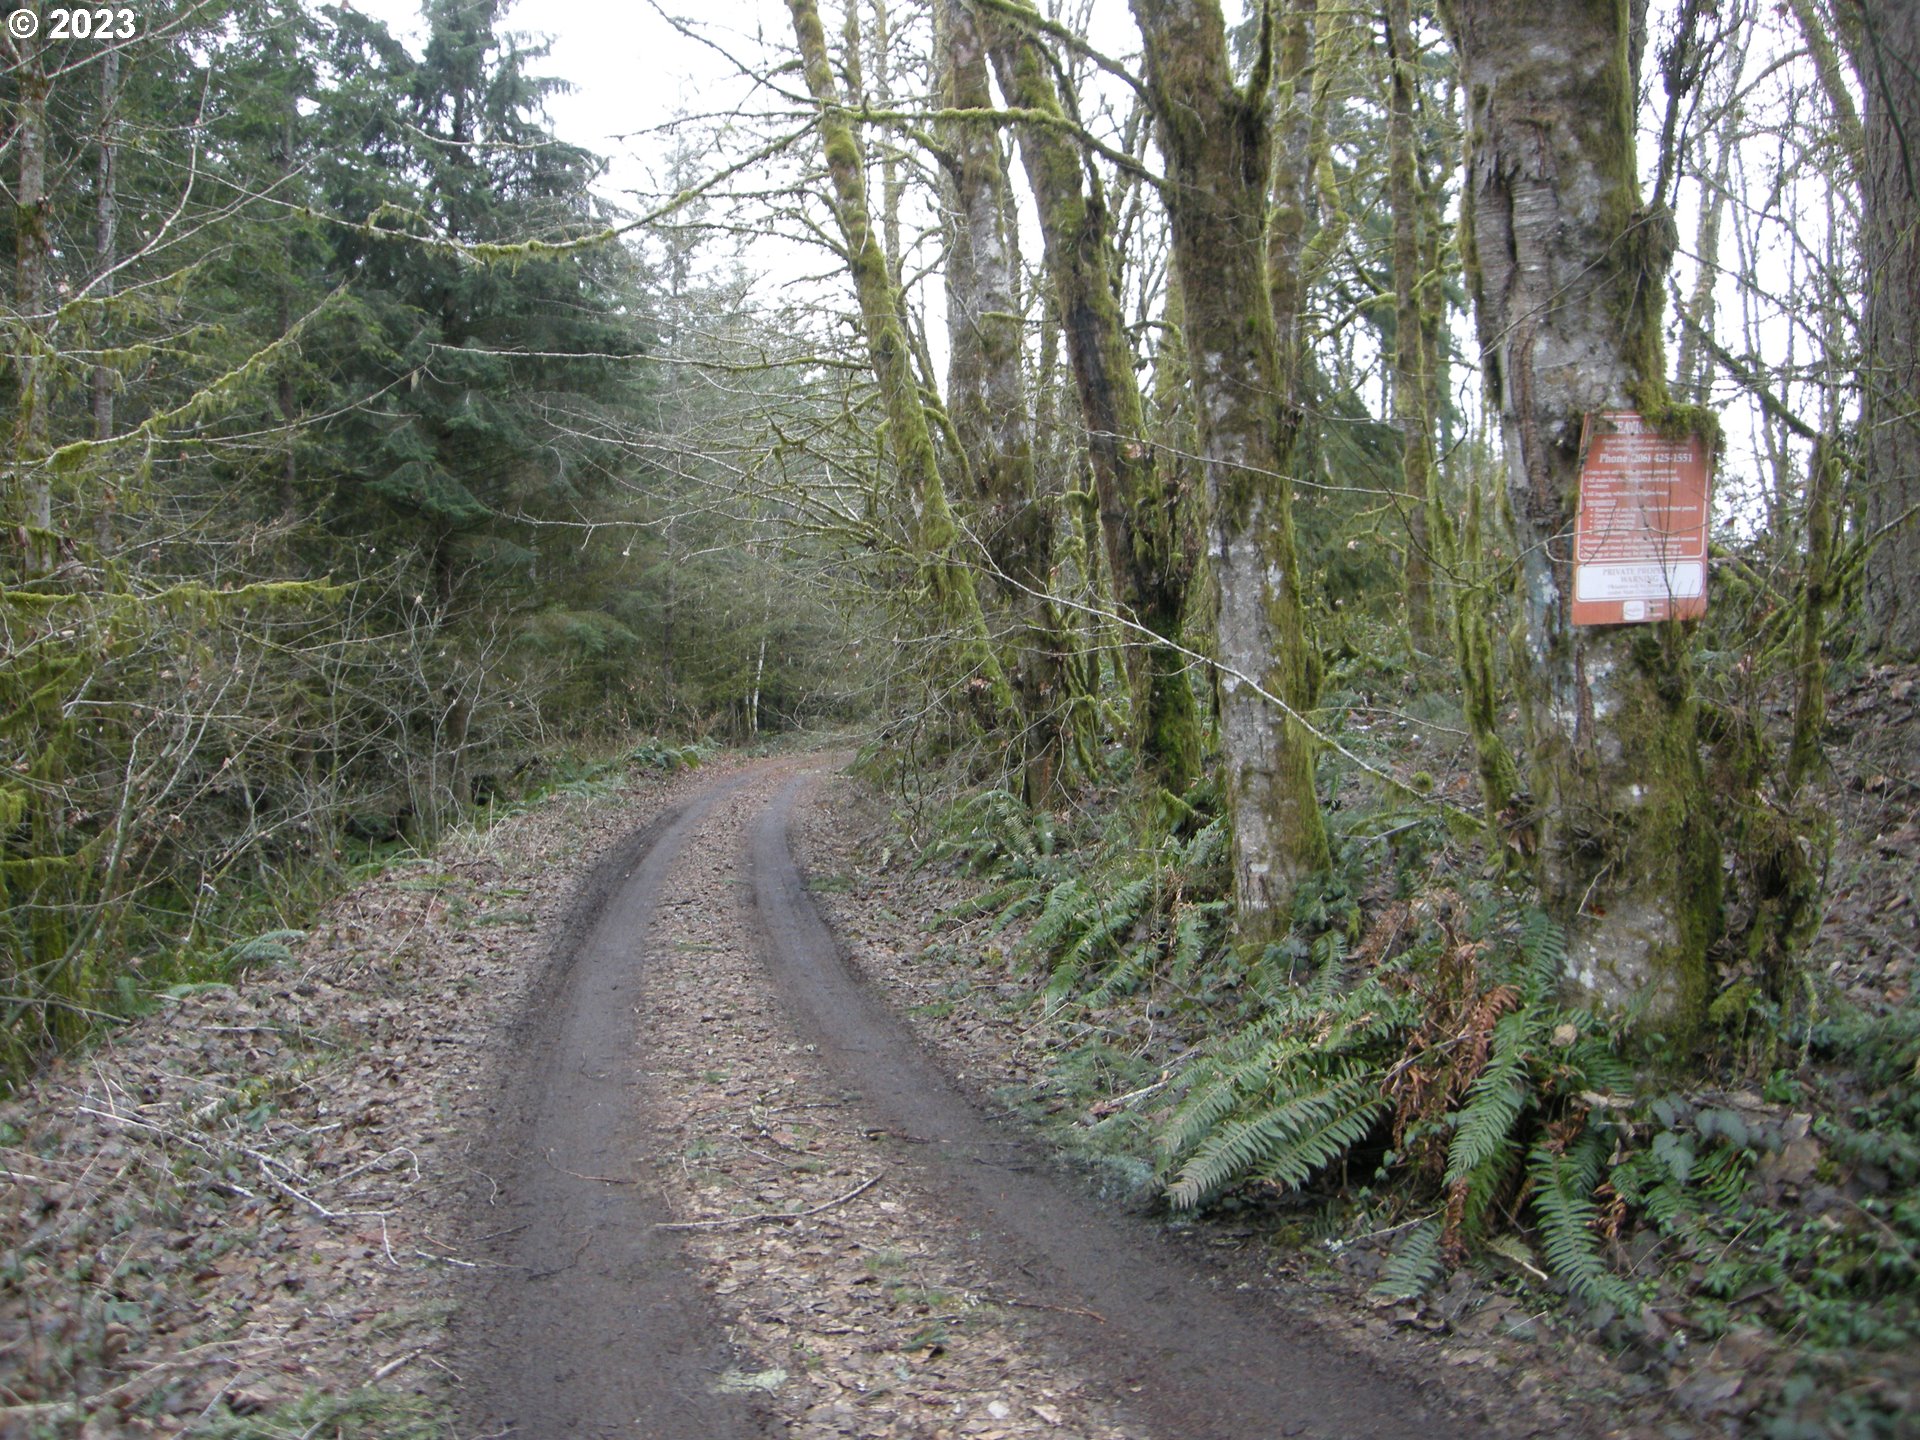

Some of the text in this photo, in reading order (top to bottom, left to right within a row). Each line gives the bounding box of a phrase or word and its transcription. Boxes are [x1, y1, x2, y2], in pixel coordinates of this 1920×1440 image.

[1599, 453, 1693, 463] Phone (206) 425-1551
[1602, 567, 1634, 576] PRIVATE
[1621, 575, 1659, 583] WARNING
